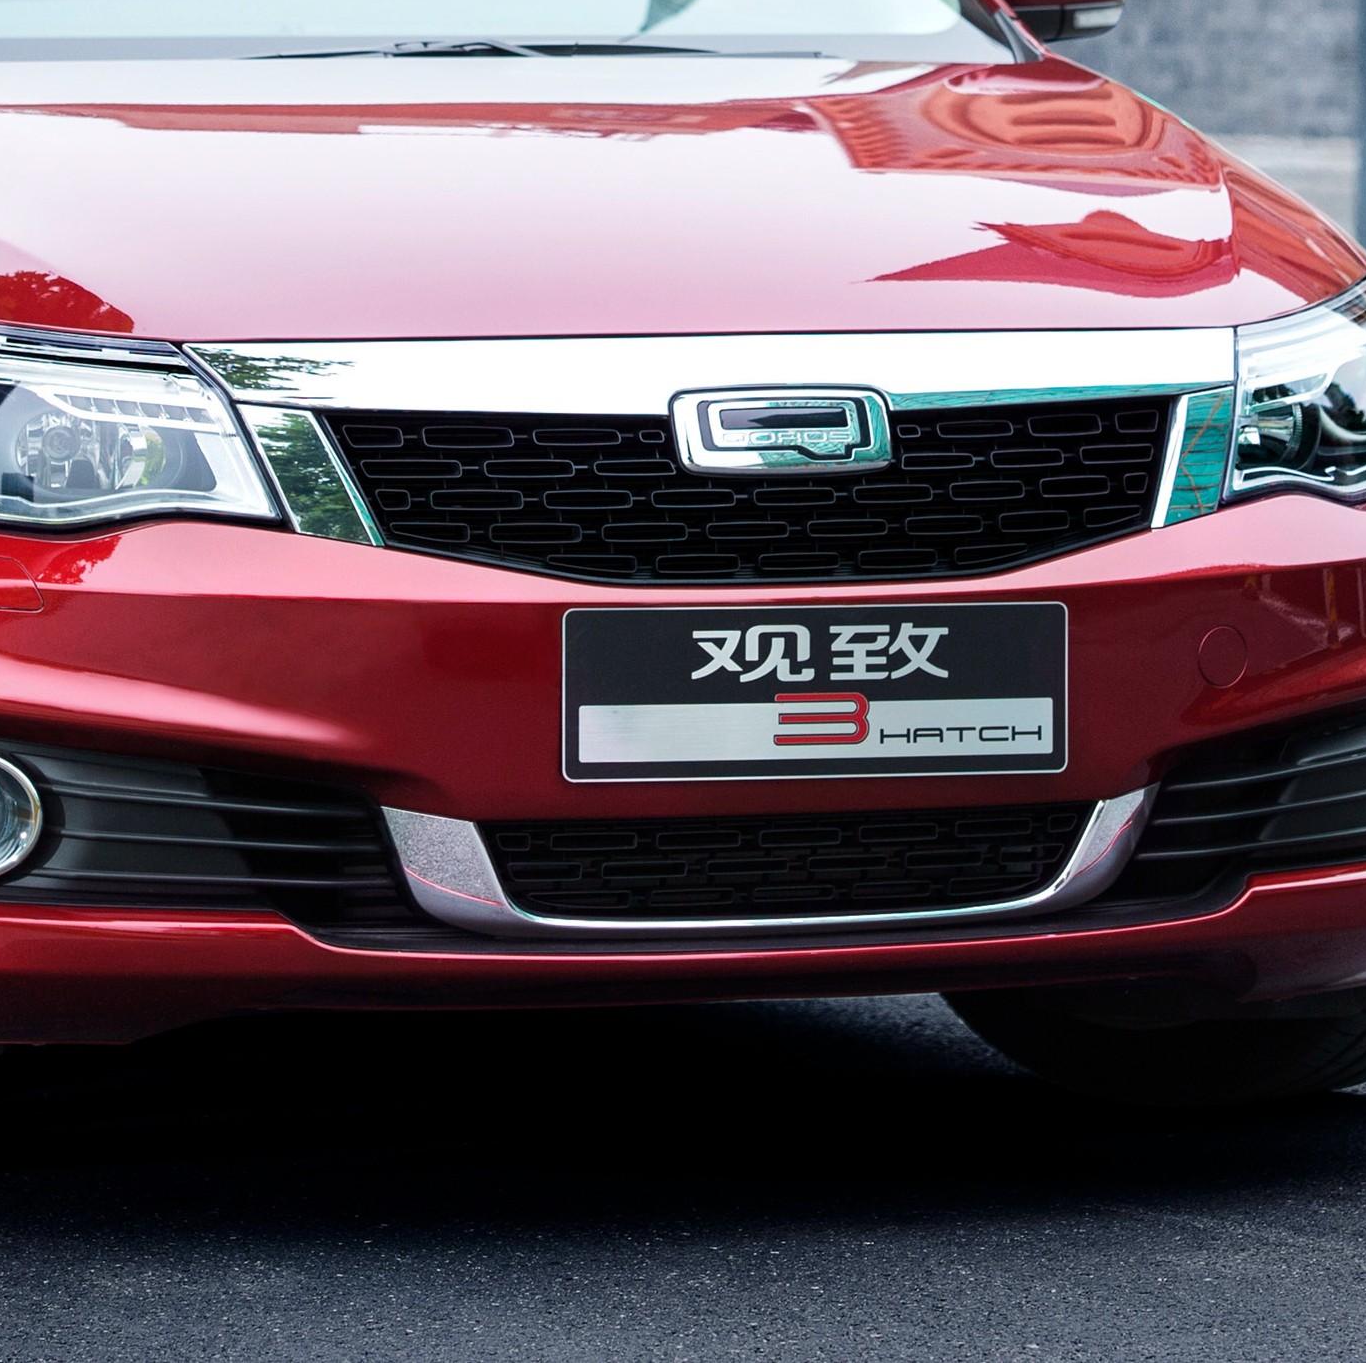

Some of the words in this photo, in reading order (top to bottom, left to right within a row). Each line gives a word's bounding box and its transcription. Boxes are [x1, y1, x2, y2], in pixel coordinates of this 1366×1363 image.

[691, 622, 949, 683] 观致
[773, 692, 870, 746] 3
[879, 725, 1043, 744] HATCH
